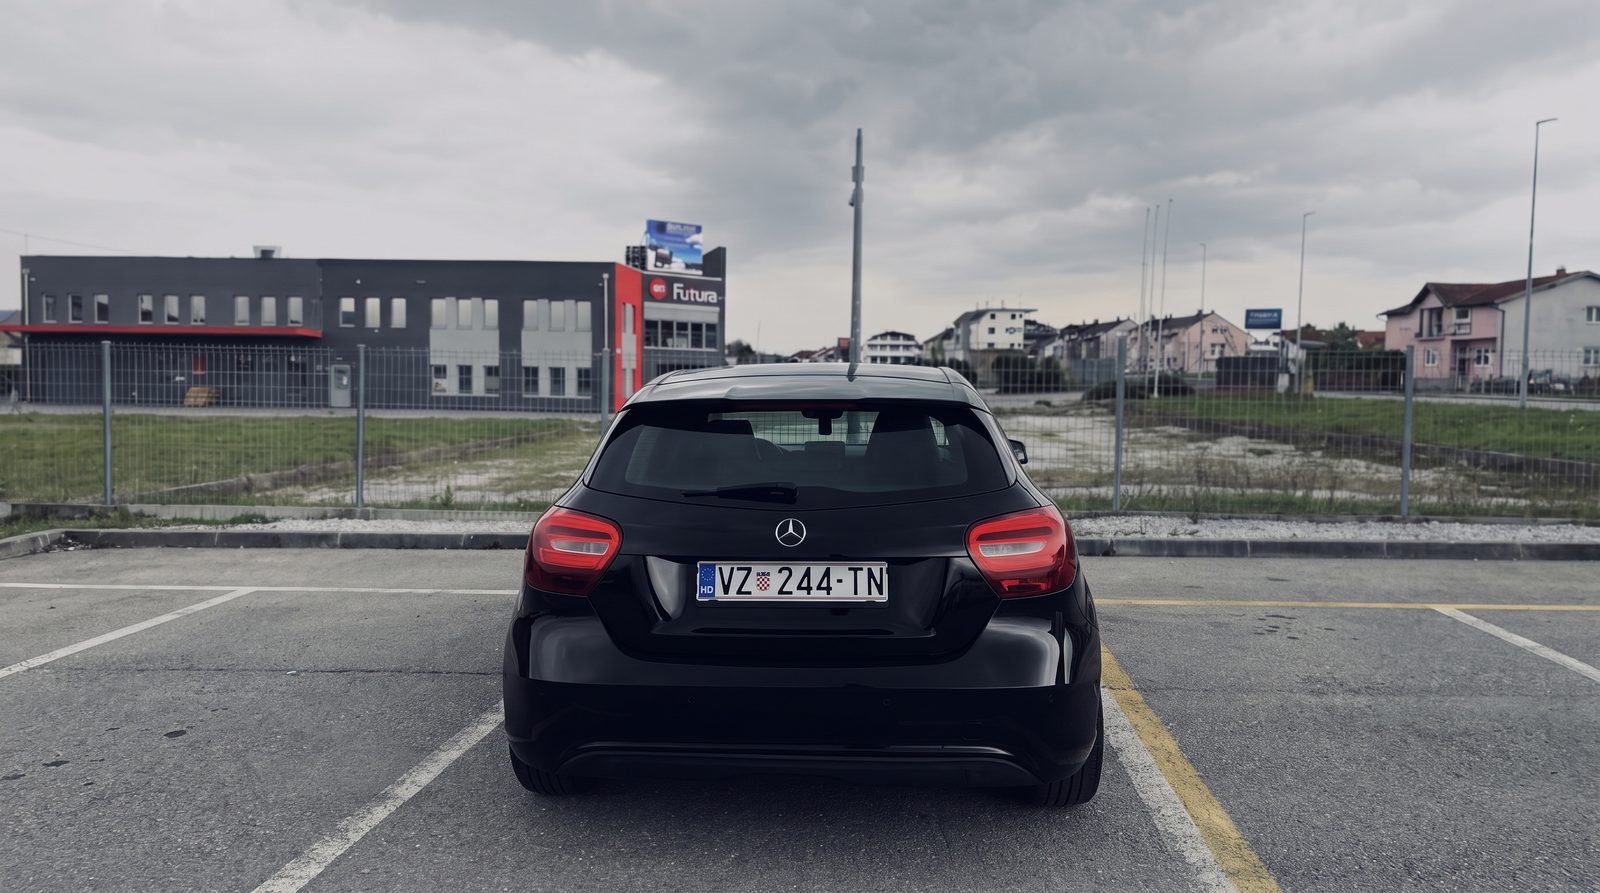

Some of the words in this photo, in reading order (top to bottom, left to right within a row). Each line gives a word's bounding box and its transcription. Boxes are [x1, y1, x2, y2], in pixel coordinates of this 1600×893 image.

[673, 283, 718, 303] Futura
[718, 566, 753, 595] VZ
[777, 566, 884, 595] 244-TN
